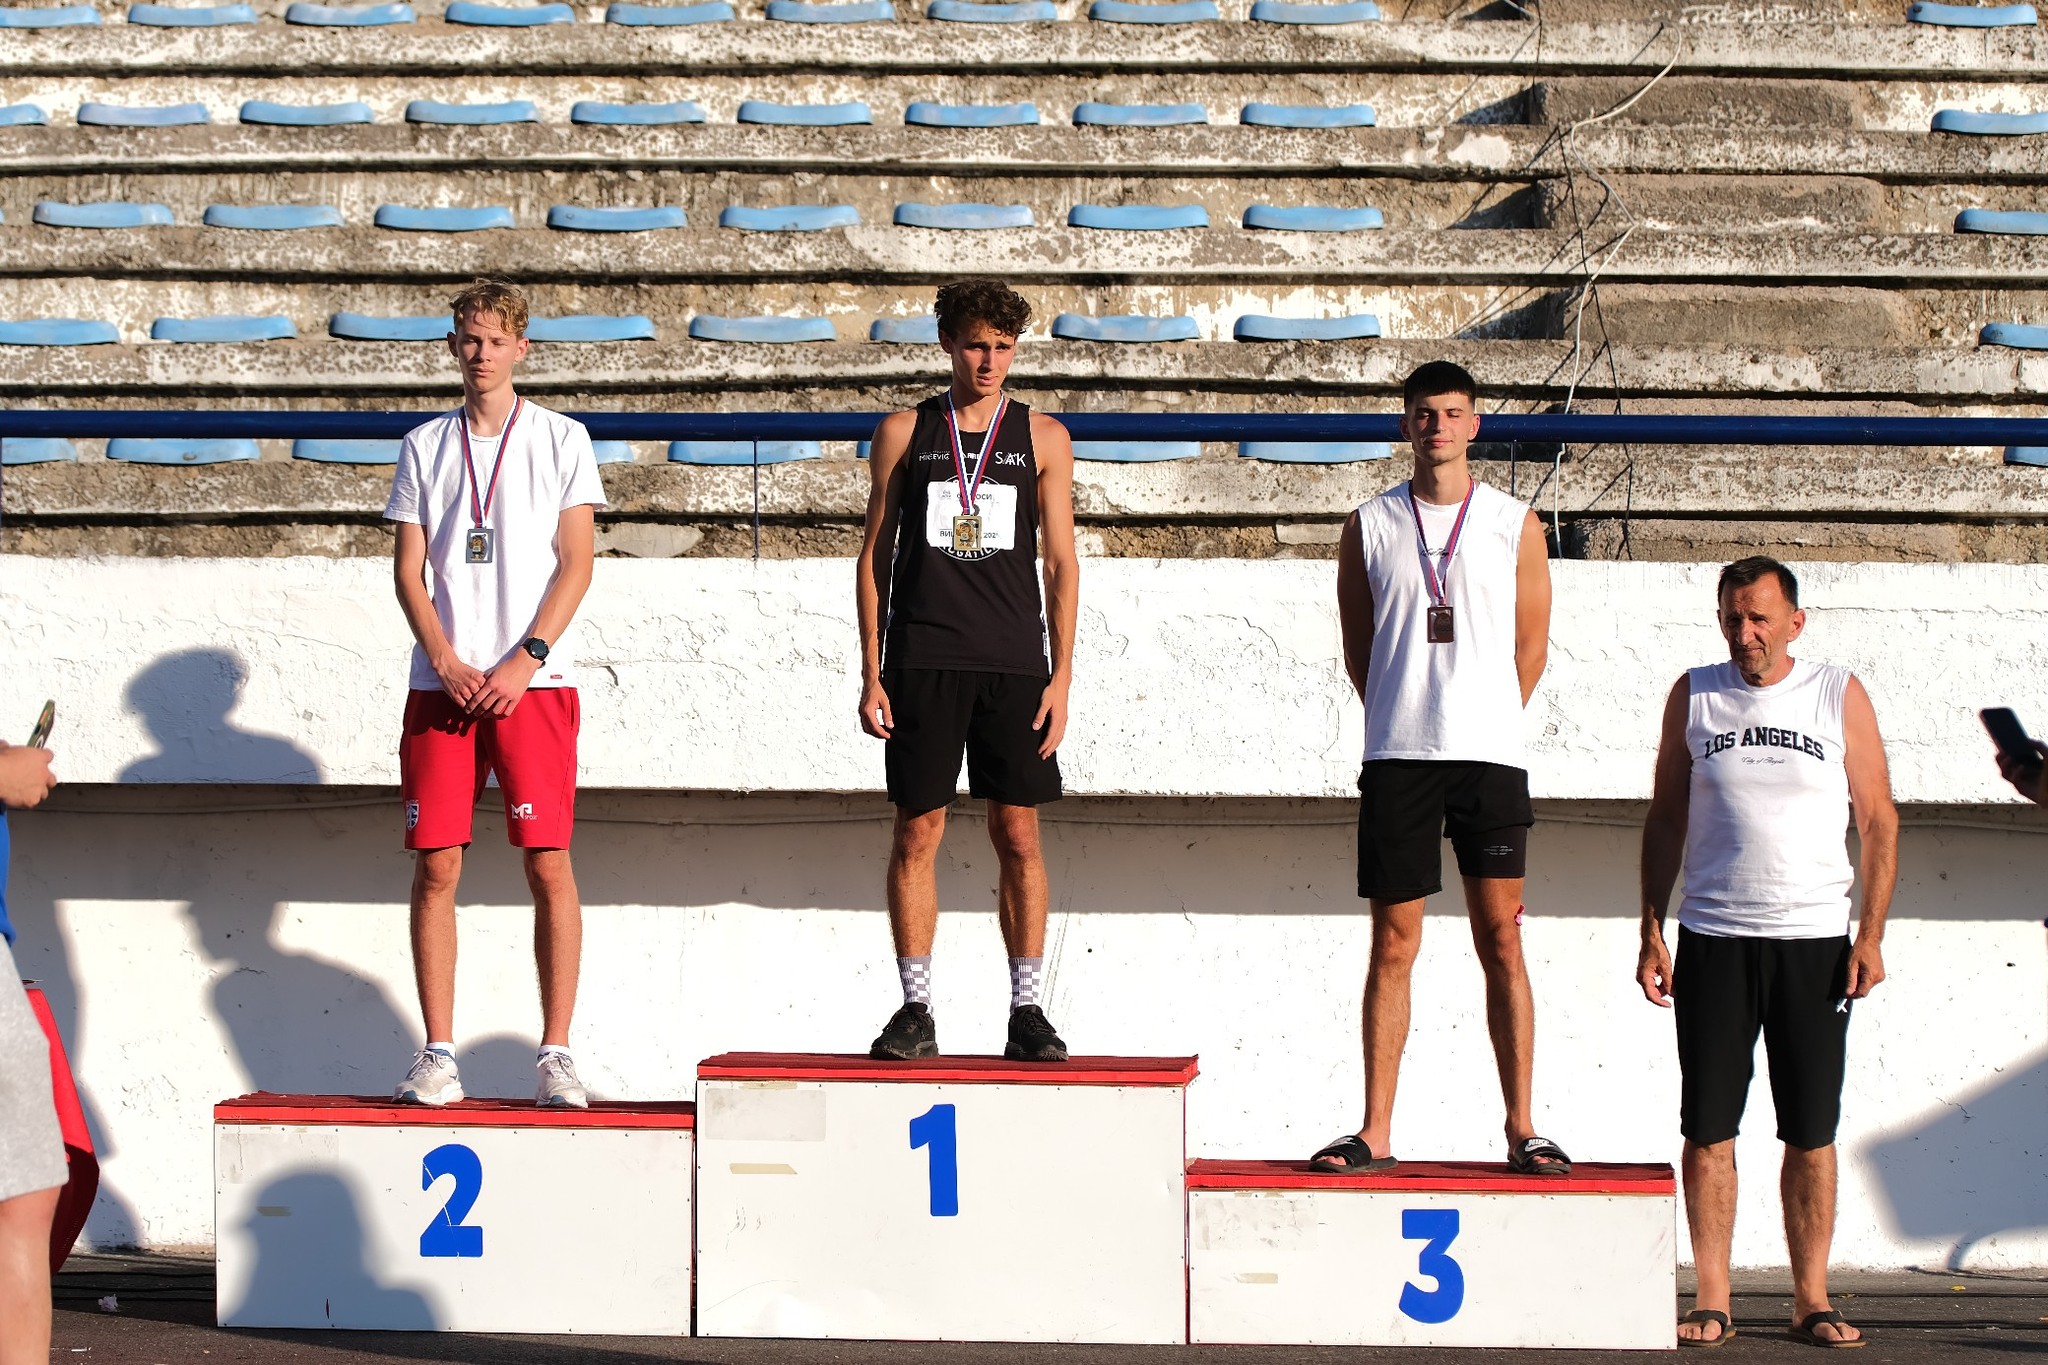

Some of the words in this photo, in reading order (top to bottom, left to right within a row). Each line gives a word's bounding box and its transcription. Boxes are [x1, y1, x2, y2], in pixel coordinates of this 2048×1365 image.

[1704, 731, 1736, 759] LOS
[1740, 726, 1825, 761] ANGELES
[420, 1143, 483, 1257] 2
[909, 1104, 958, 1216] 1
[1399, 1209, 1464, 1324] 3
